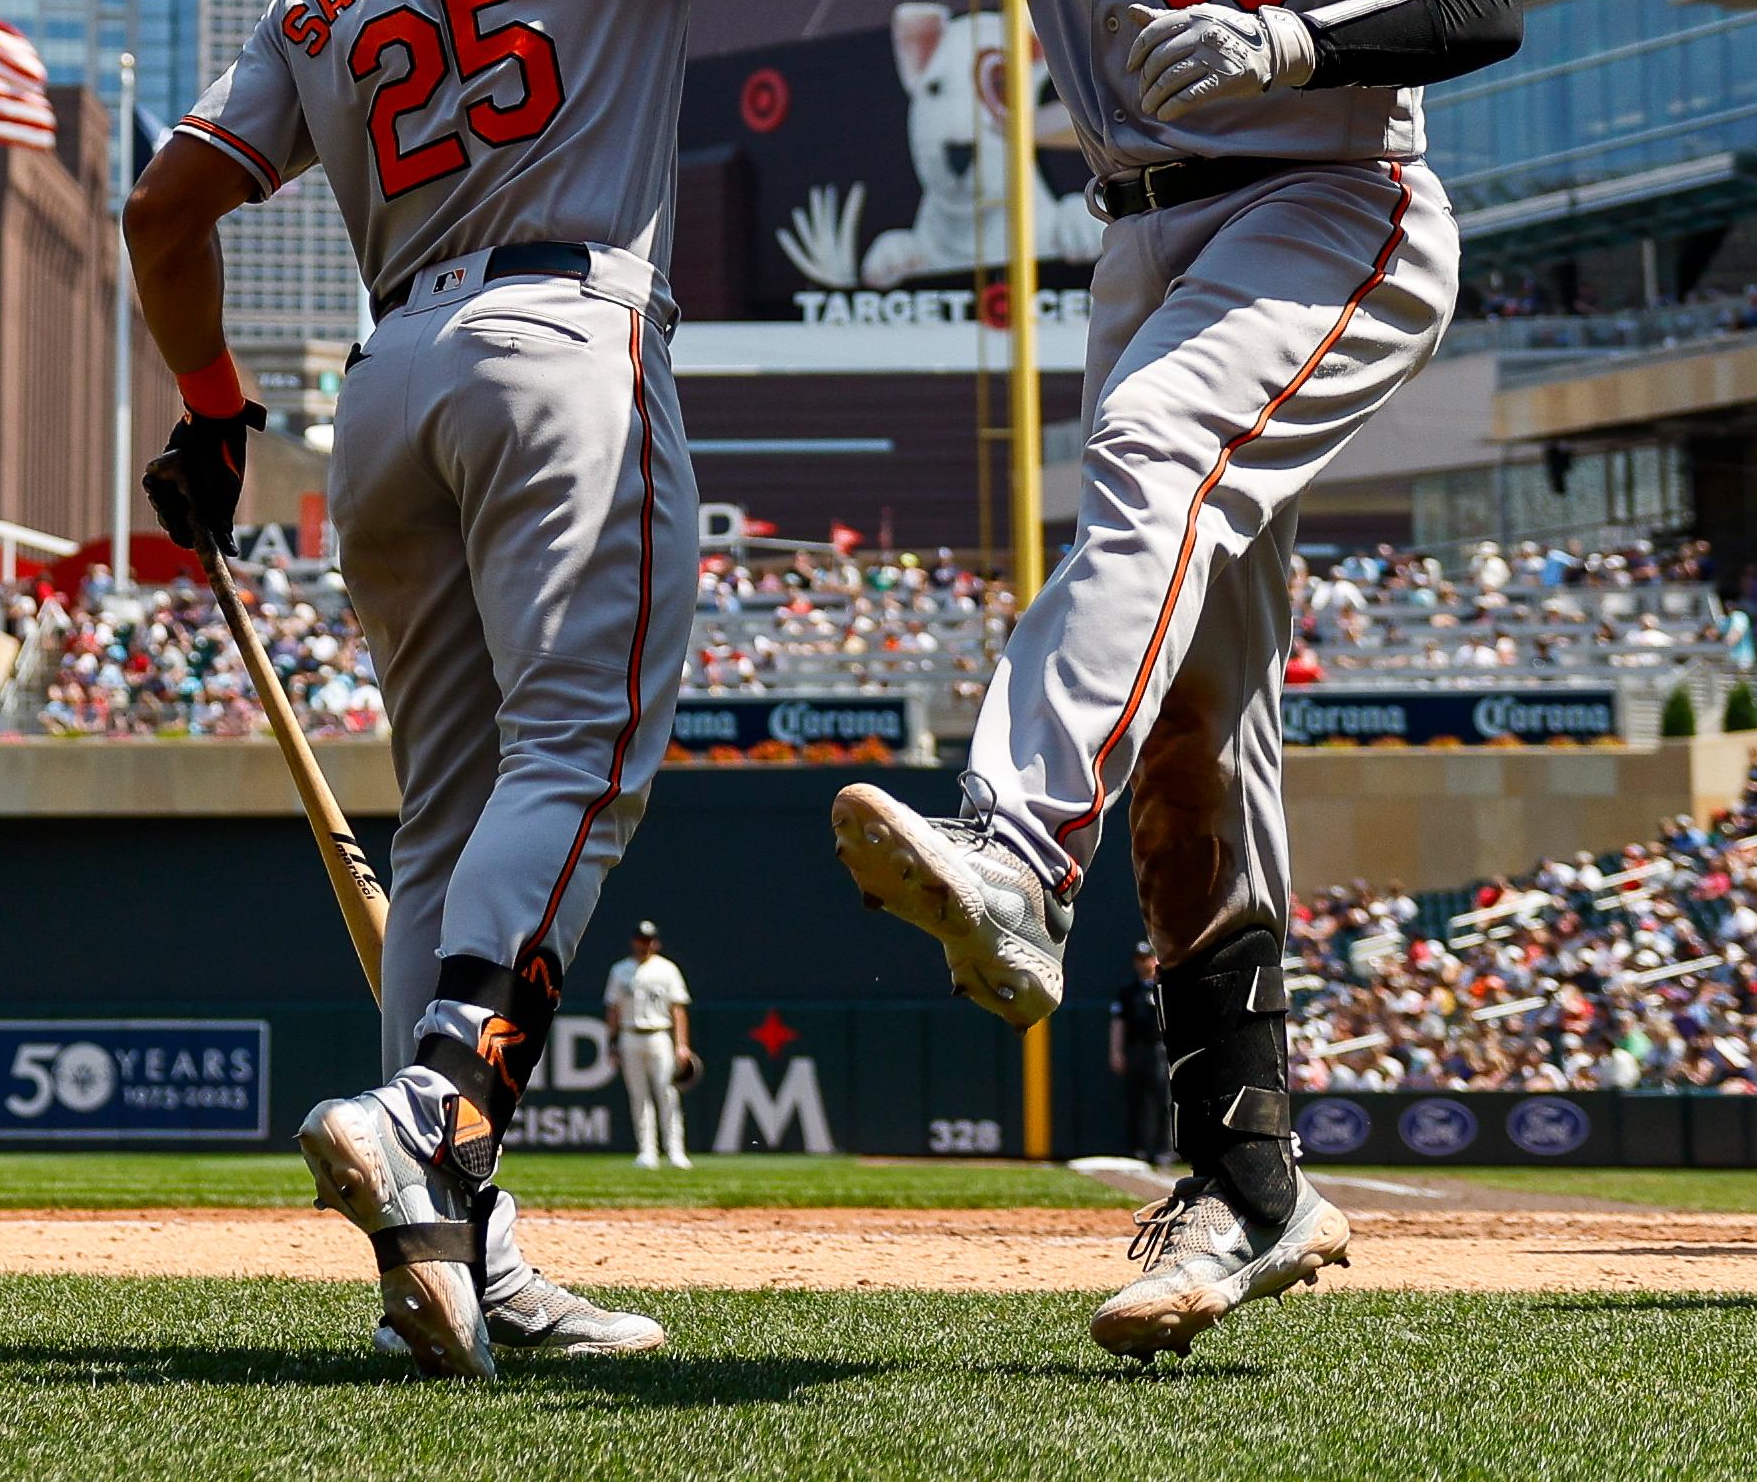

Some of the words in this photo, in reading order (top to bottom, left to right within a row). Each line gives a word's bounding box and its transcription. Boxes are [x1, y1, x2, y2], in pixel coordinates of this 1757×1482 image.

[793, 290, 976, 326] TARGET
[1473, 694, 1610, 739] Corona
[335, 844, 375, 900] marucci
[4, 1041, 119, 1118] 50
[114, 1047, 253, 1083] YEARS
[928, 1120, 1002, 1153] 328
